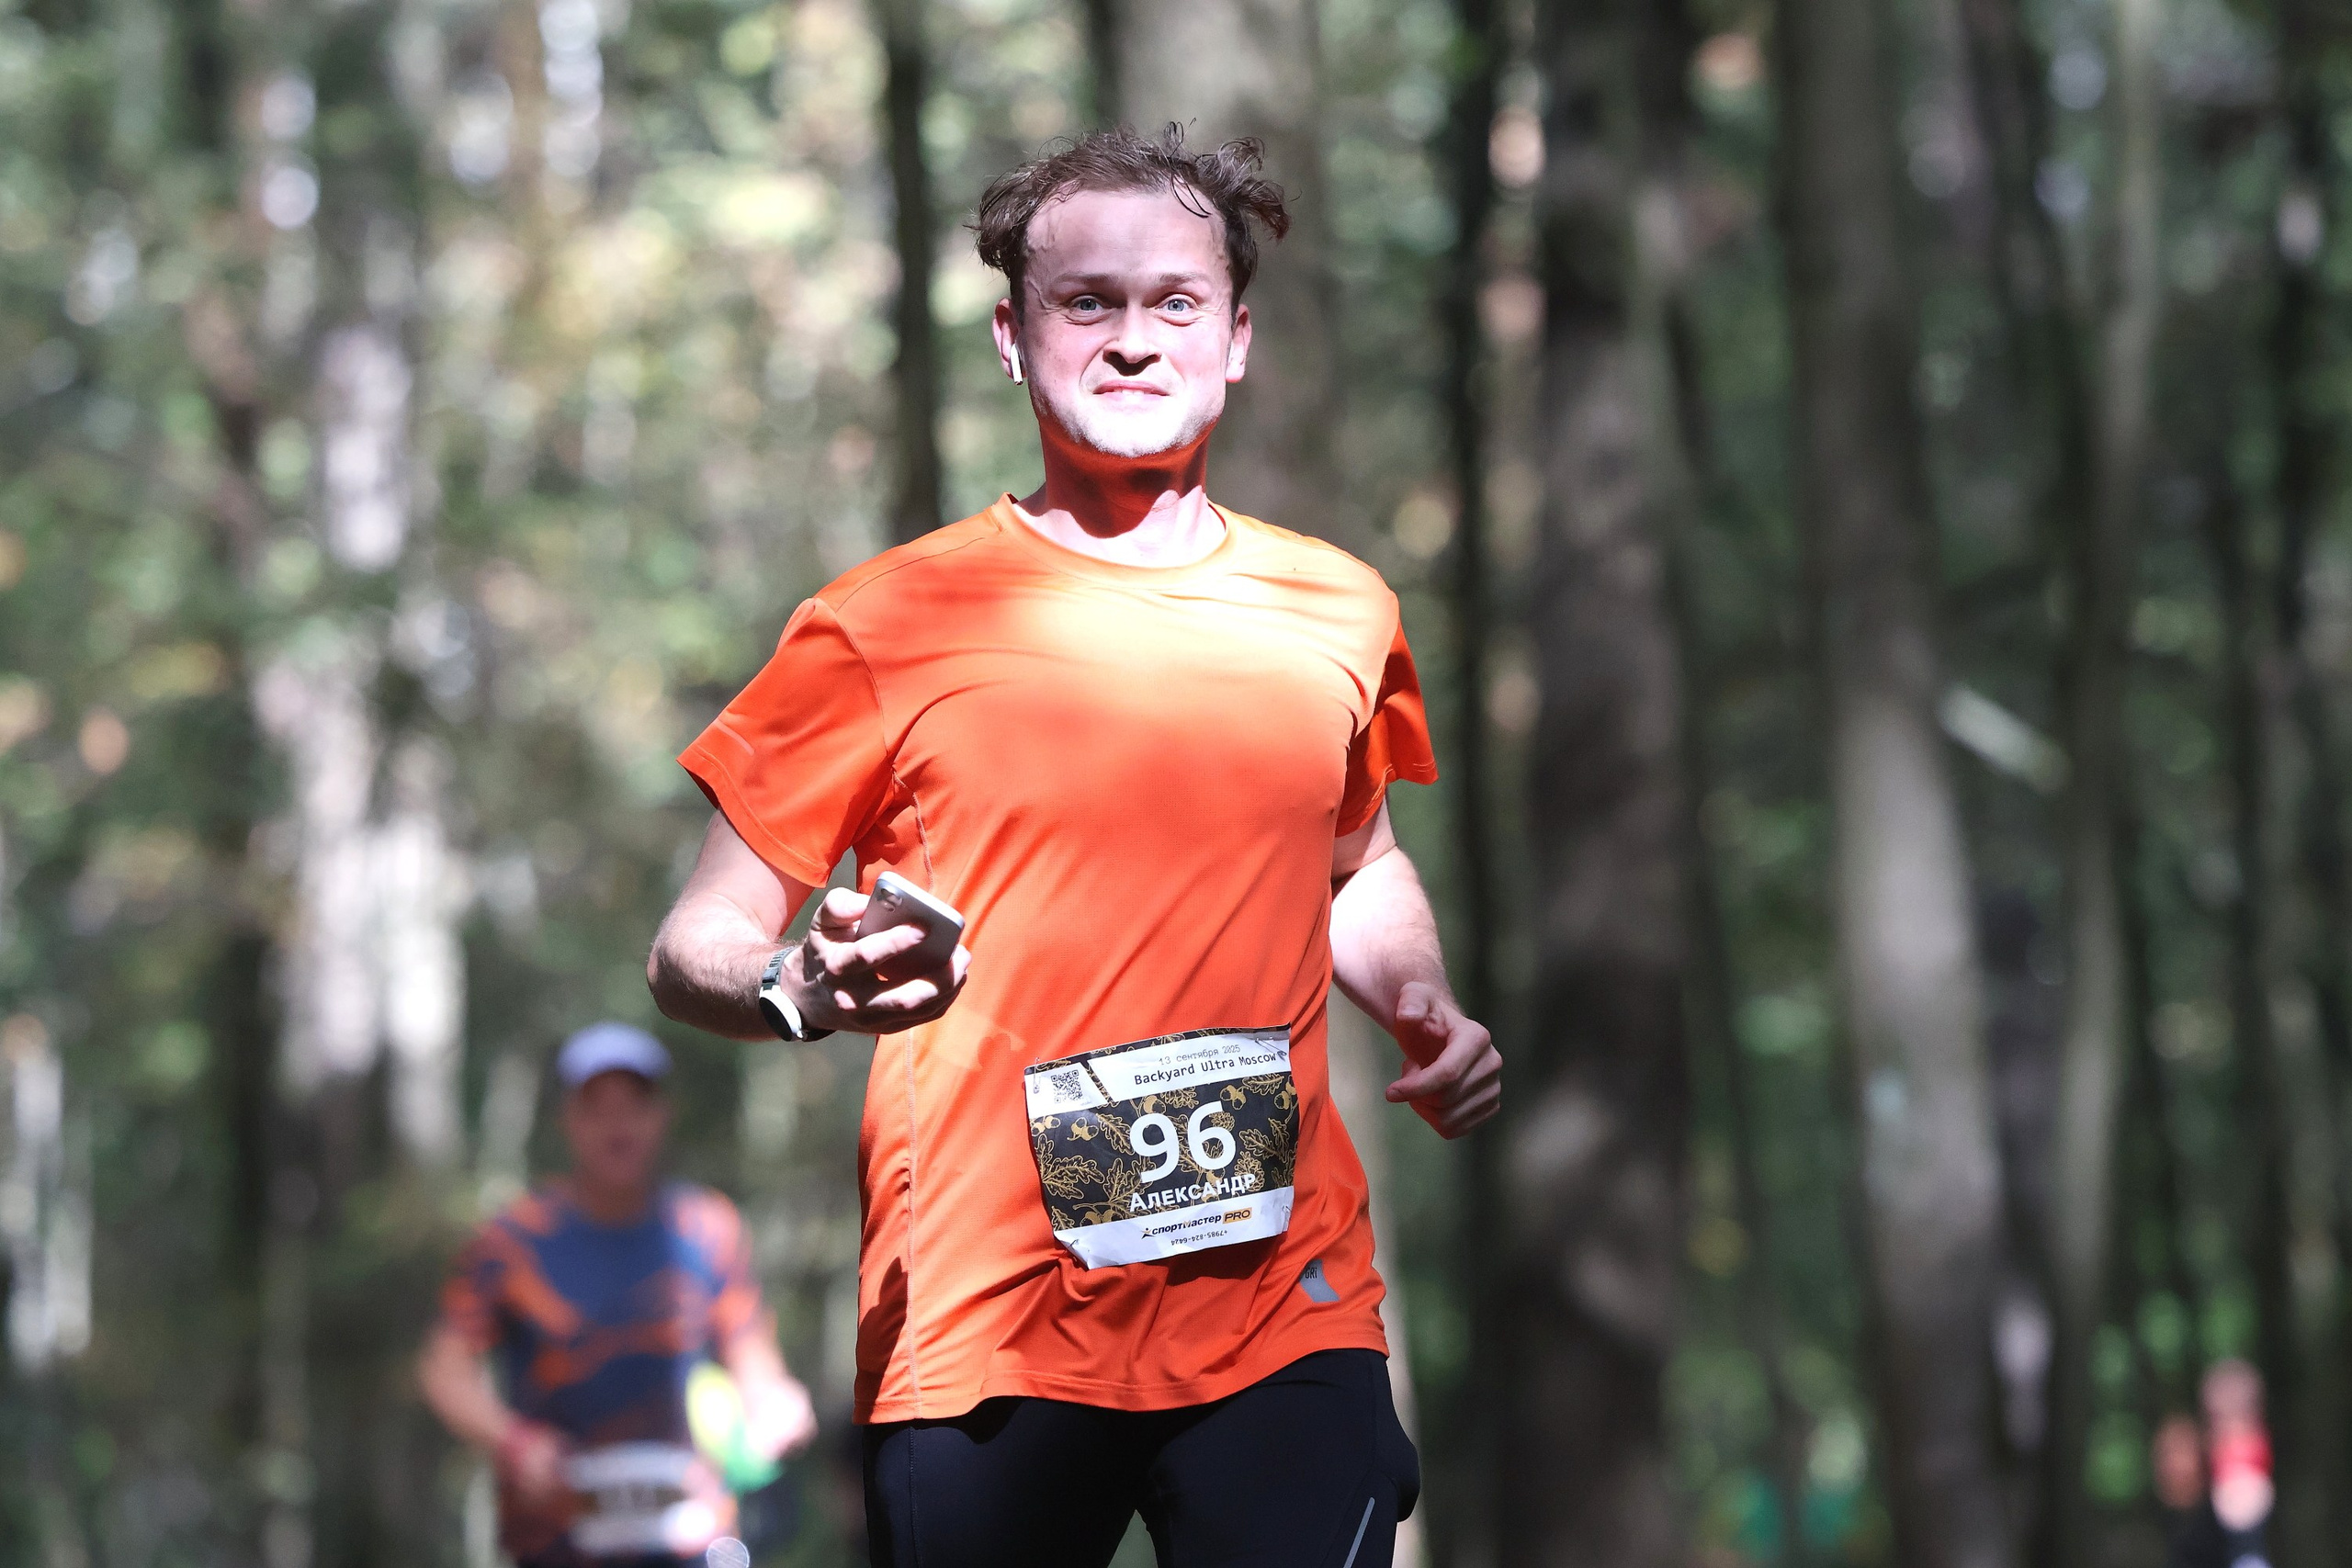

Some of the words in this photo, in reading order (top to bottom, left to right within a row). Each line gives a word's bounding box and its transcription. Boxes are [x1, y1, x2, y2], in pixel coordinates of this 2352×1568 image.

[1134, 1064, 1195, 1085] Backyard
[1201, 1058, 1235, 1072] Ultra
[1239, 1053, 1277, 1066] Moscow
[1159, 1056, 1171, 1066] 13
[1176, 1049, 1219, 1062] сентября
[1222, 1044, 1240, 1055] 2025
[1129, 1100, 1237, 1184] 96
[1129, 1174, 1256, 1213] АЛЕКСАНДР
[1224, 1210, 1250, 1223] PRO
